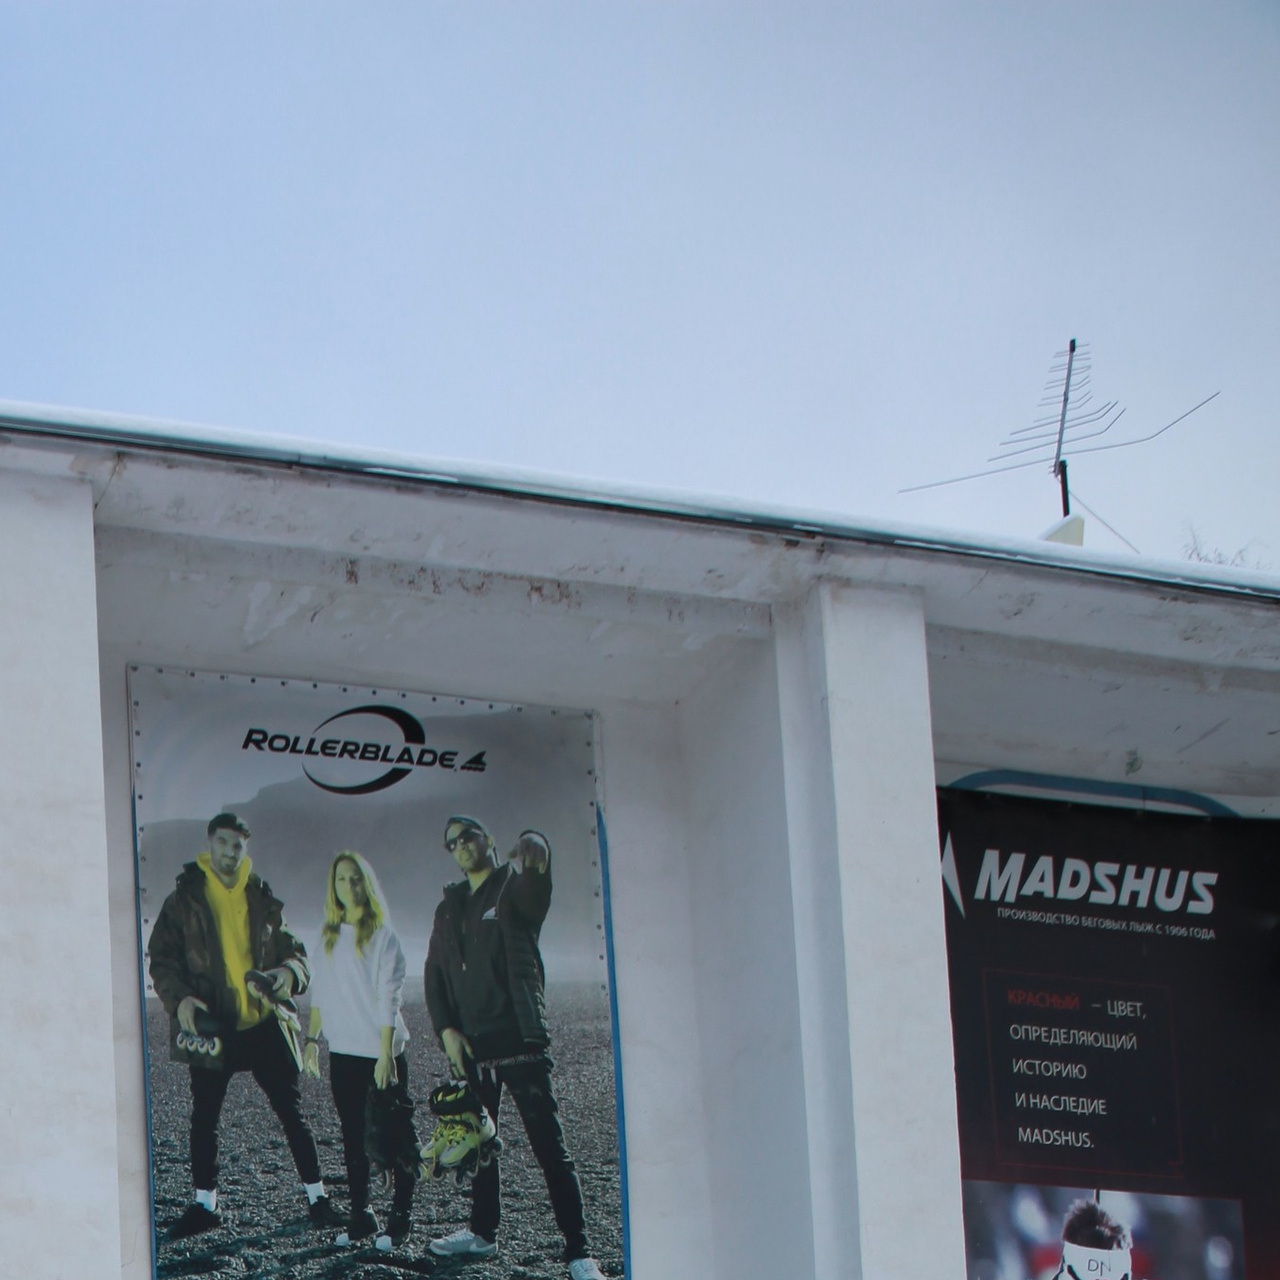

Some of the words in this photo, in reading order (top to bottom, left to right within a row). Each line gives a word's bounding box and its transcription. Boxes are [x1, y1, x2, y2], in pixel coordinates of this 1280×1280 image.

[241, 728, 459, 769] ROLLERBLADE
[974, 849, 1219, 915] MADSHUS
[997, 907, 1079, 926] ПРОИЗВОДСТВО
[1081, 915, 1127, 931] БЕГОВЫХ
[1165, 924, 1188, 937] 1906
[1189, 927, 1216, 940] ГОДА
[1007, 989, 1081, 1010] КРАСНЫЙ
[1106, 999, 1147, 1019] ЦВЕТ,
[1009, 1024, 1138, 1051] ОПРЕДЕЛЯЮЩИЙ
[1012, 1058, 1088, 1080] ИСТОРИЮ
[1014, 1092, 1026, 1108] И
[1029, 1094, 1107, 1116] НАСЛЕДИЕ
[1018, 1127, 1095, 1149] MADSHUS.
